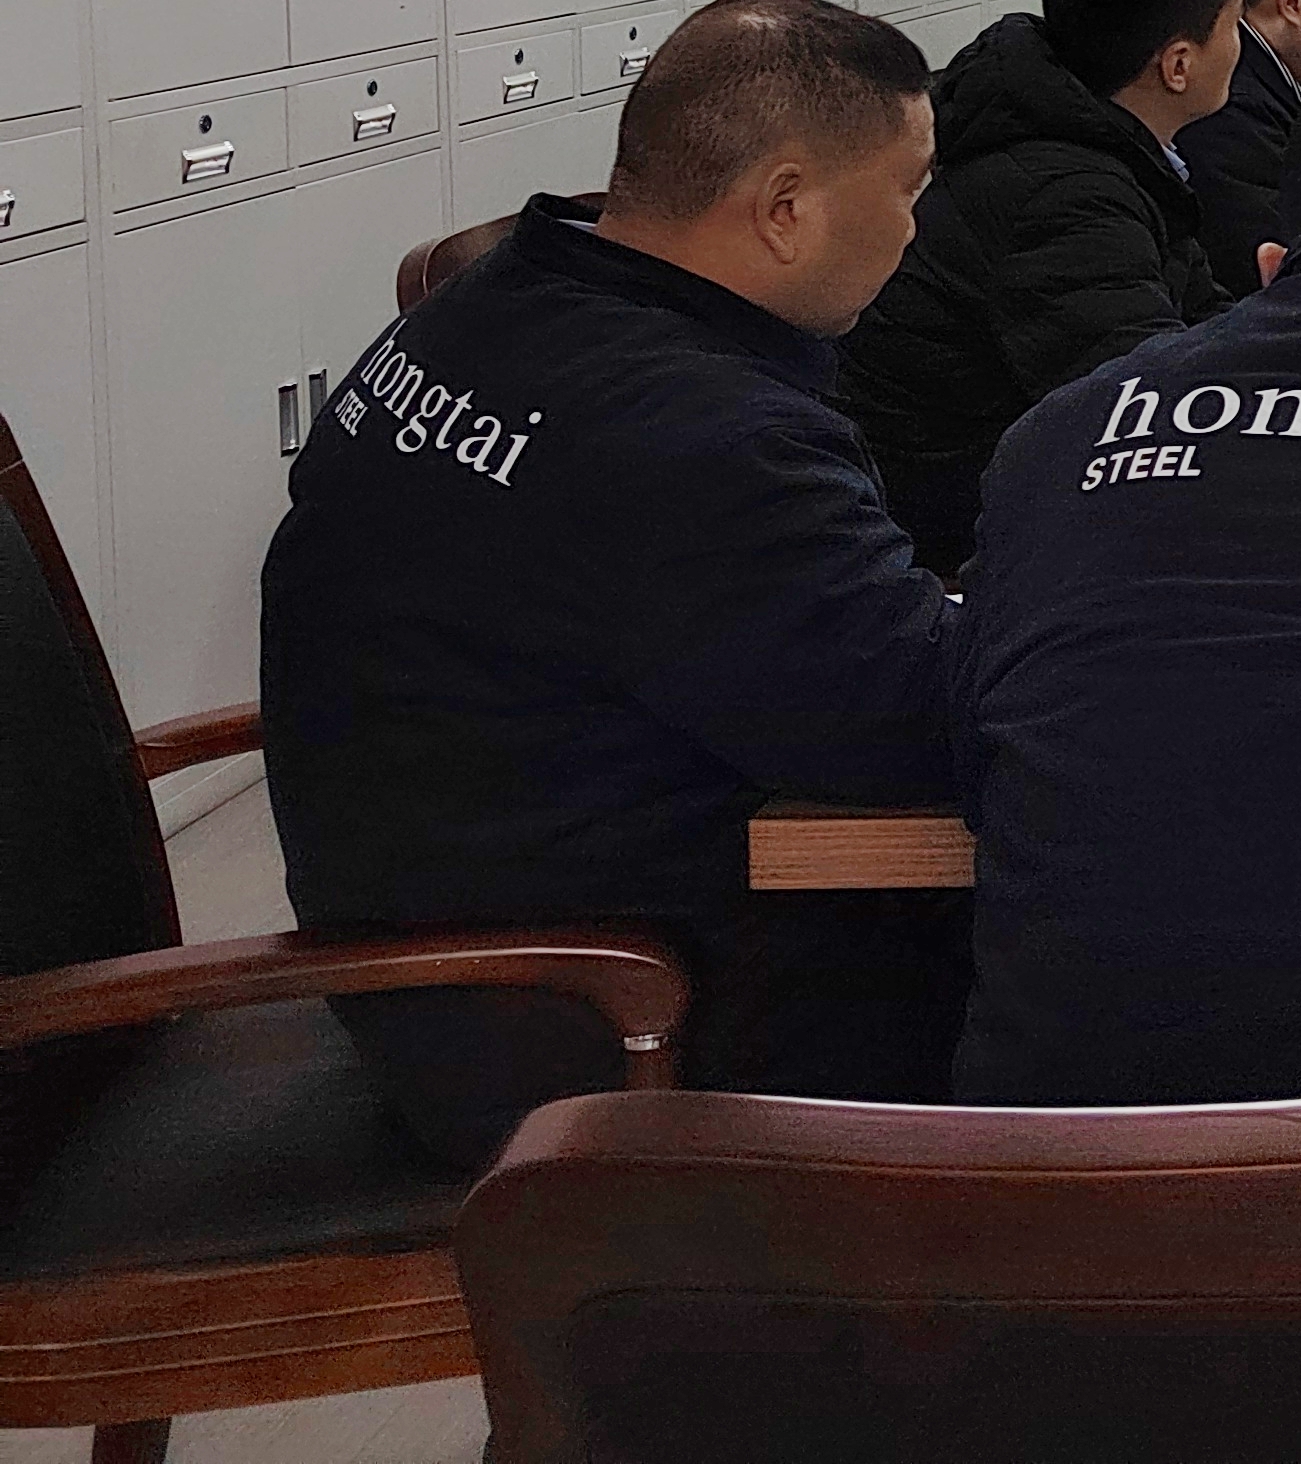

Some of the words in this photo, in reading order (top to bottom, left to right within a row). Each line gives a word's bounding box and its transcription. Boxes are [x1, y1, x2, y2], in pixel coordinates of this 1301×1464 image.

[334, 388, 369, 436] STEEL
[360, 318, 542, 486] hongtai
[1081, 445, 1201, 491] STEEL
